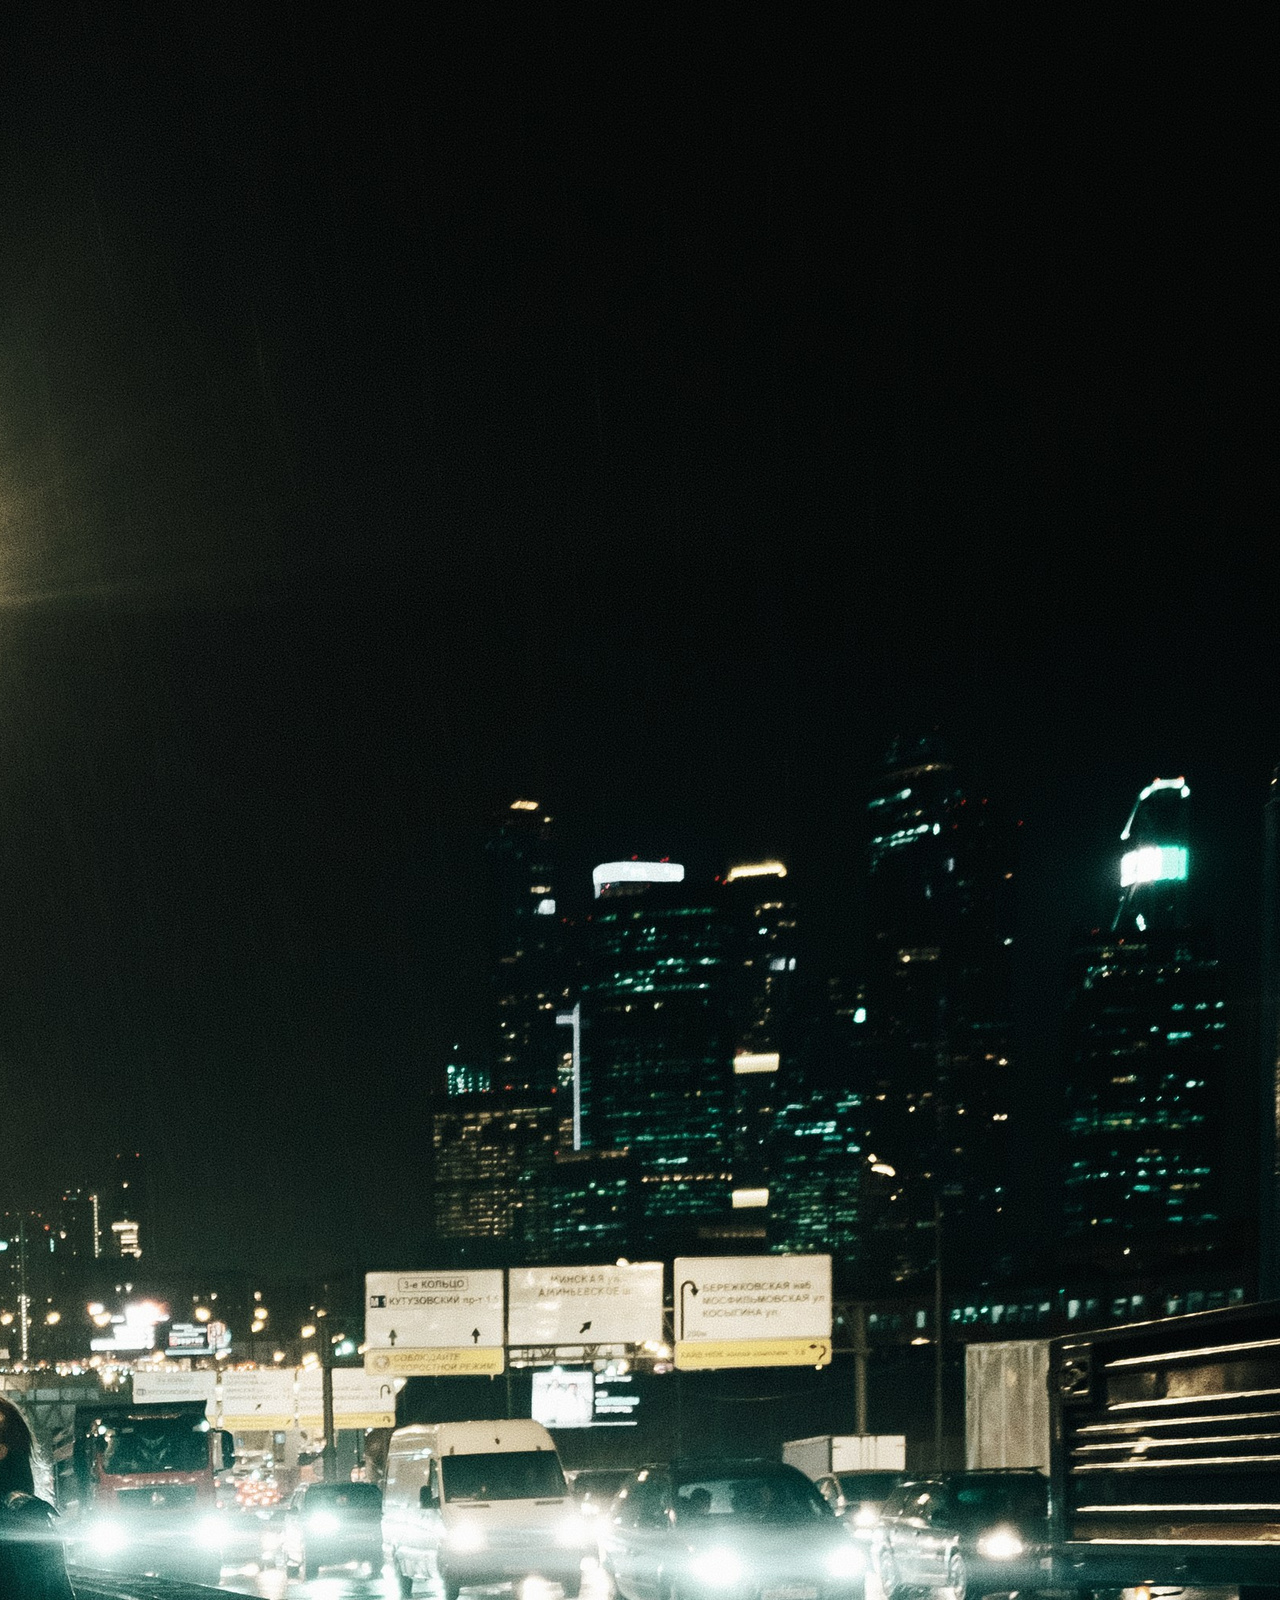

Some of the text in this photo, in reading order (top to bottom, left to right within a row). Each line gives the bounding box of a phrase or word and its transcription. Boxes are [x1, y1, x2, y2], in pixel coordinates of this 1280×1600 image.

[421, 1279, 465, 1290] КОЛЬЦО
[702, 1281, 790, 1292] БЕРЕЖКОВСКАЯ
[389, 1295, 460, 1306] КУТУЗОВСКИЙ
[702, 1294, 810, 1305] МОСФИЛЬМОВСКАЯ
[702, 1308, 762, 1318] КОСЫГИНА
[393, 1353, 461, 1362] СОБЛЮДАЙТЕ
